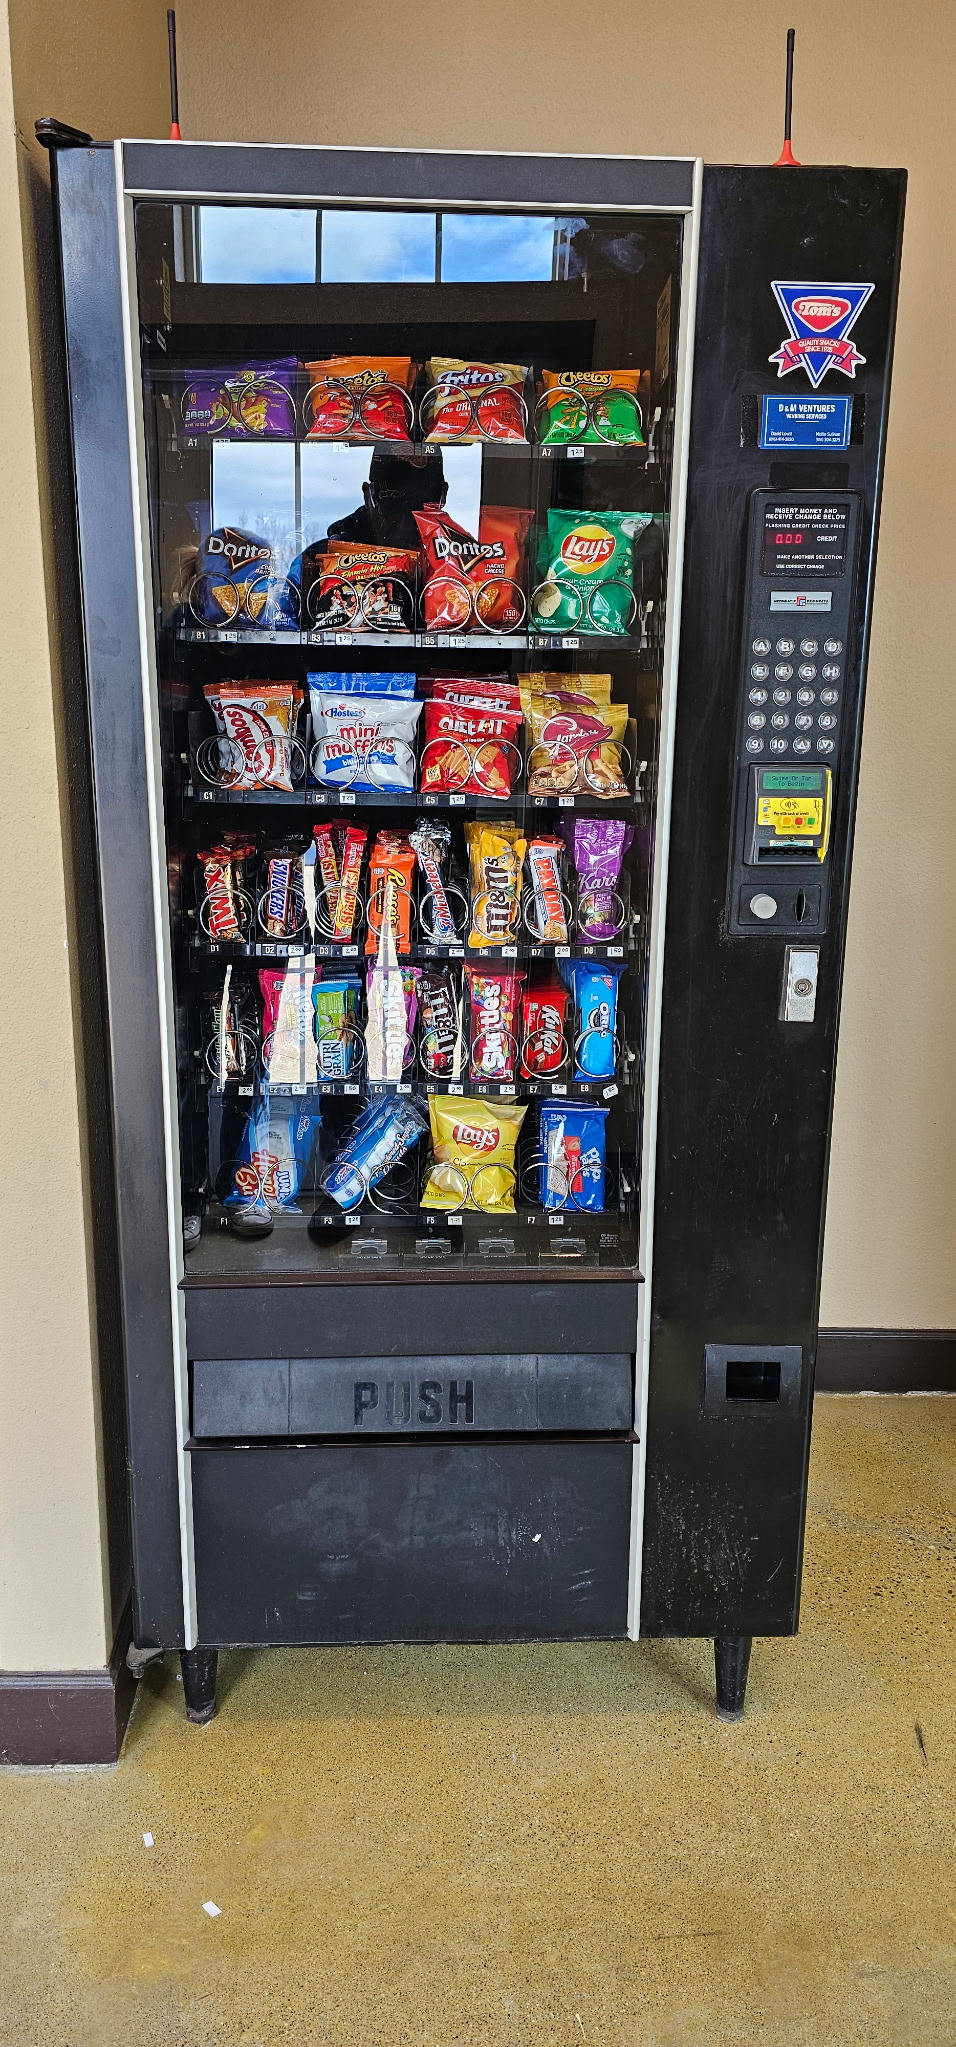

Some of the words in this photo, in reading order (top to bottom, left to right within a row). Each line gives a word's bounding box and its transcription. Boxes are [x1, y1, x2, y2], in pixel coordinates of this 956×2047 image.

[798, 302, 842, 317] Tom's
[798, 338, 818, 348] QUALITY
[820, 338, 840, 348] SNACKS
[438, 369, 505, 398] Fritos
[559, 371, 610, 386] Cheetos
[456, 398, 500, 412] ORINAL
[778, 404, 784, 412] D
[798, 404, 836, 413] VENTURES
[188, 438, 197, 446] A1
[425, 446, 435, 454] A5
[542, 448, 552, 456] A7
[208, 536, 278, 560] Doritos
[434, 536, 504, 558] Doritos
[564, 534, 613, 564] Lay's
[338, 552, 387, 568] Cheetos
[196, 632, 205, 640] B1
[758, 642, 765, 651] A
[782, 642, 790, 651] B
[805, 642, 814, 652] C
[829, 642, 837, 651] D
[757, 667, 764, 676] E
[780, 667, 787, 676] F
[803, 667, 812, 676] G
[827, 667, 836, 676] H
[779, 692, 786, 701] 2
[803, 692, 809, 701] 3
[826, 692, 832, 701] 4
[330, 708, 362, 717] Hostess
[778, 716, 784, 725] 6
[824, 716, 830, 725] 8
[340, 722, 381, 740] mini
[325, 738, 395, 758] muffins
[752, 740, 758, 749] 9
[774, 740, 784, 749] 10
[204, 792, 213, 800] C1
[578, 872, 618, 892] Kar's
[268, 859, 289, 922] SNICKERS
[534, 858, 566, 924] PAYDAY
[480, 984, 505, 1068] Skittles
[332, 1042, 342, 1076] GRAIN
[456, 1124, 498, 1149] Lay's
[353, 1379, 475, 1427] PUSH
